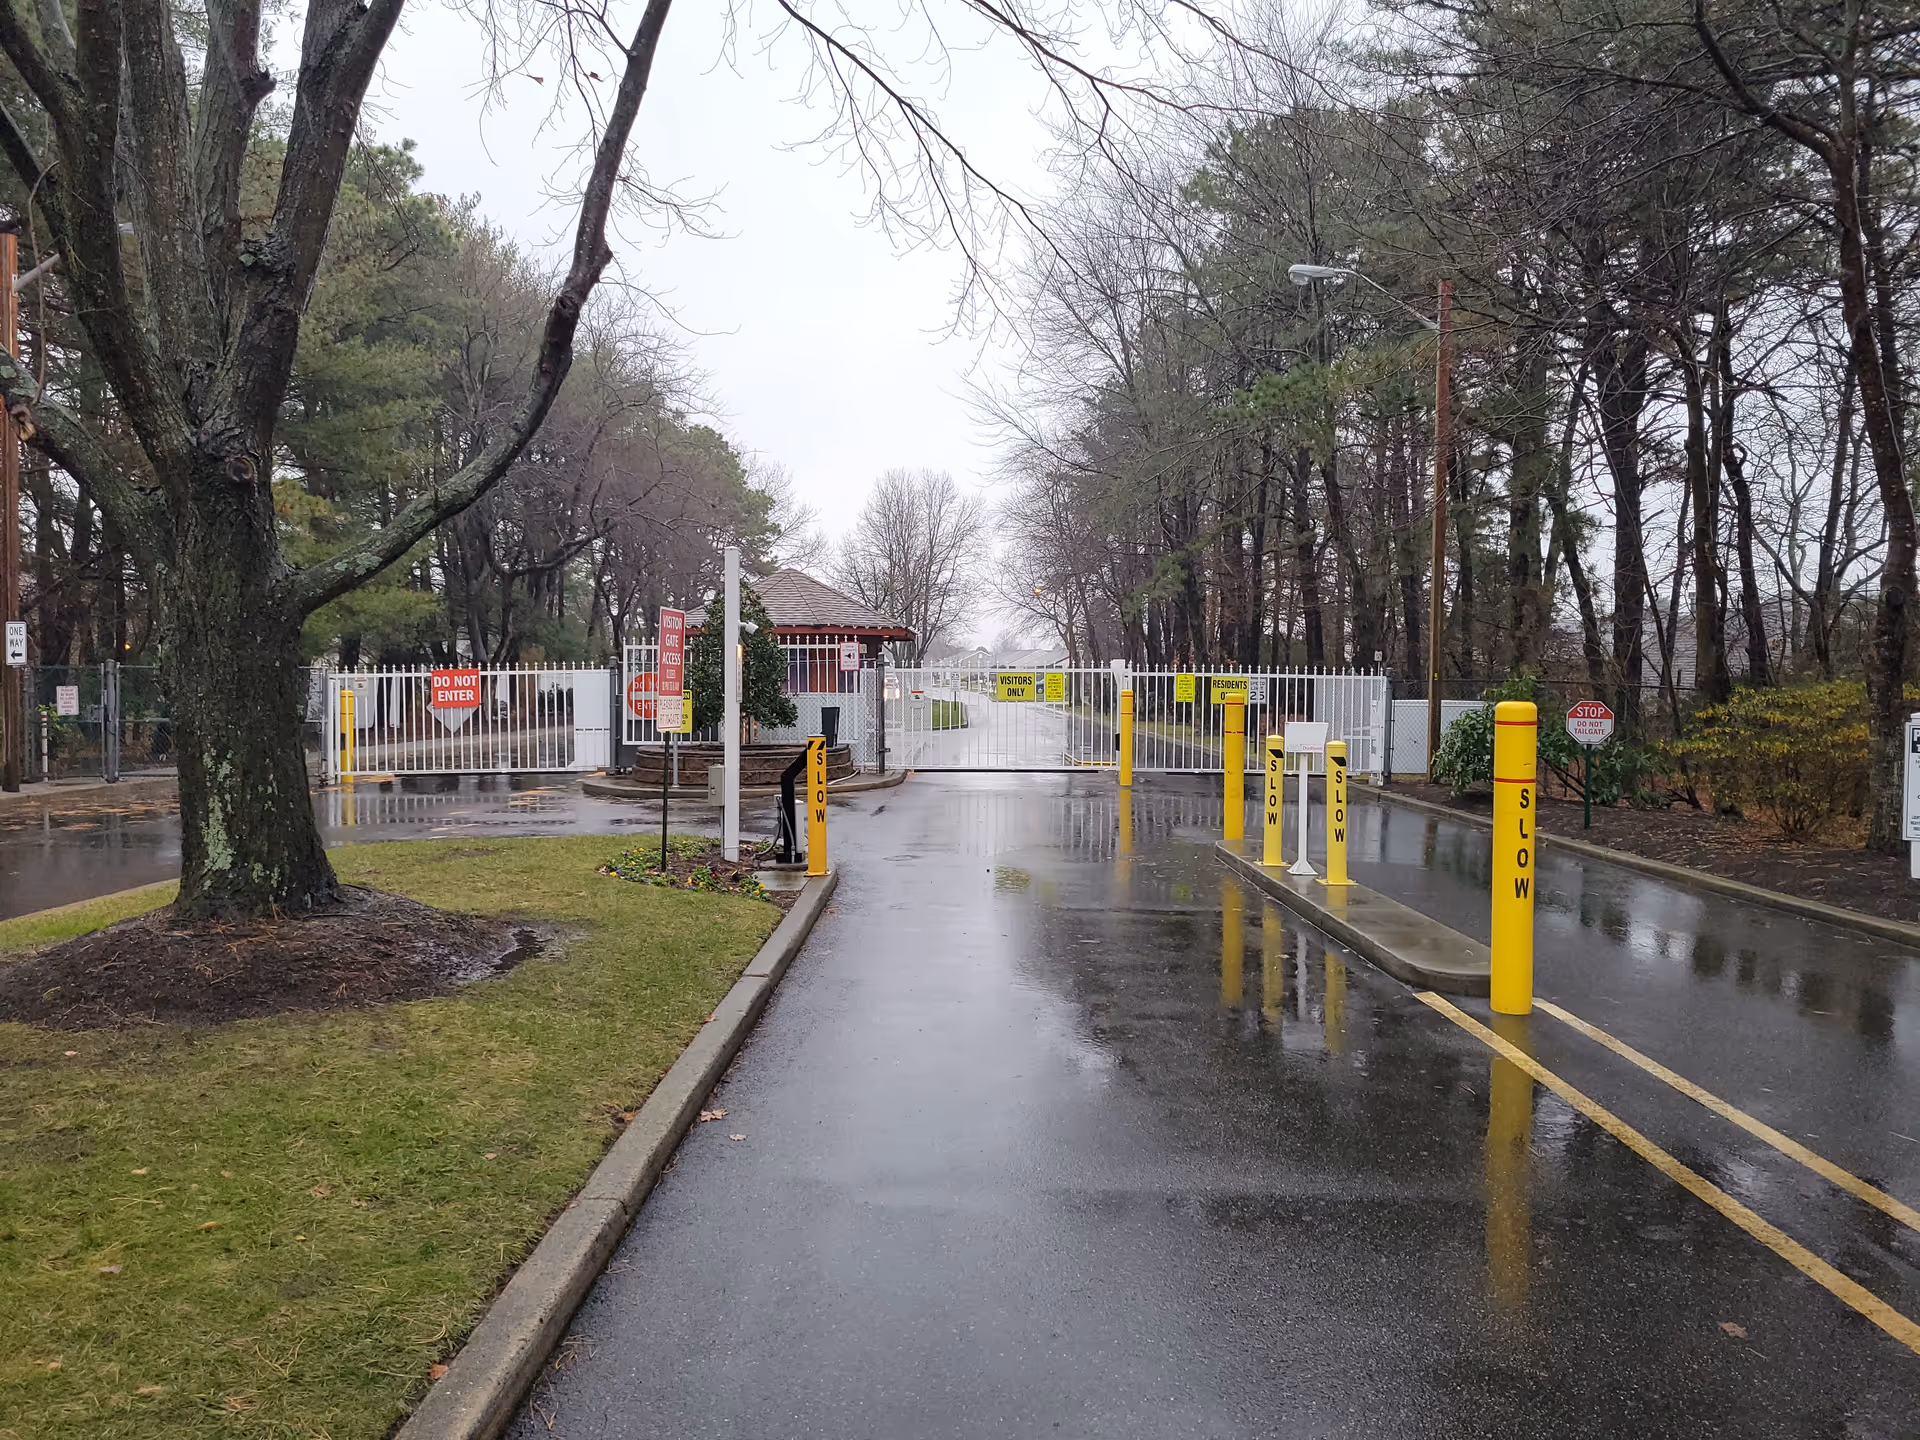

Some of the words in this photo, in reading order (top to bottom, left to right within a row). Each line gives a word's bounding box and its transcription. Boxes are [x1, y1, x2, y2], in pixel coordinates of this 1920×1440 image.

[662, 614, 683, 631] VISITOR
[9, 626, 23, 636] ONE
[9, 638, 24, 648] WAY
[665, 633, 679, 648] GATE
[661, 651, 681, 666] ACCESS
[433, 676, 450, 688] DO
[454, 675, 477, 687] NOT
[1000, 675, 1032, 686] VISITORS
[1212, 679, 1248, 690] RESIDENTS
[437, 690, 474, 702] ENTER
[1007, 687, 1025, 697] ONLY
[1250, 690, 1265, 701] 25
[637, 702, 657, 710] ENTE
[1576, 706, 1605, 718] STOP
[1576, 720, 1587, 728] DO
[1588, 720, 1603, 728] NOT
[1573, 728, 1606, 736] TAILGATE
[816, 752, 825, 823] SLOW
[1268, 759, 1278, 825] SLOW
[1334, 770, 1344, 842] SLOW
[1514, 788, 1530, 899] SLOW
